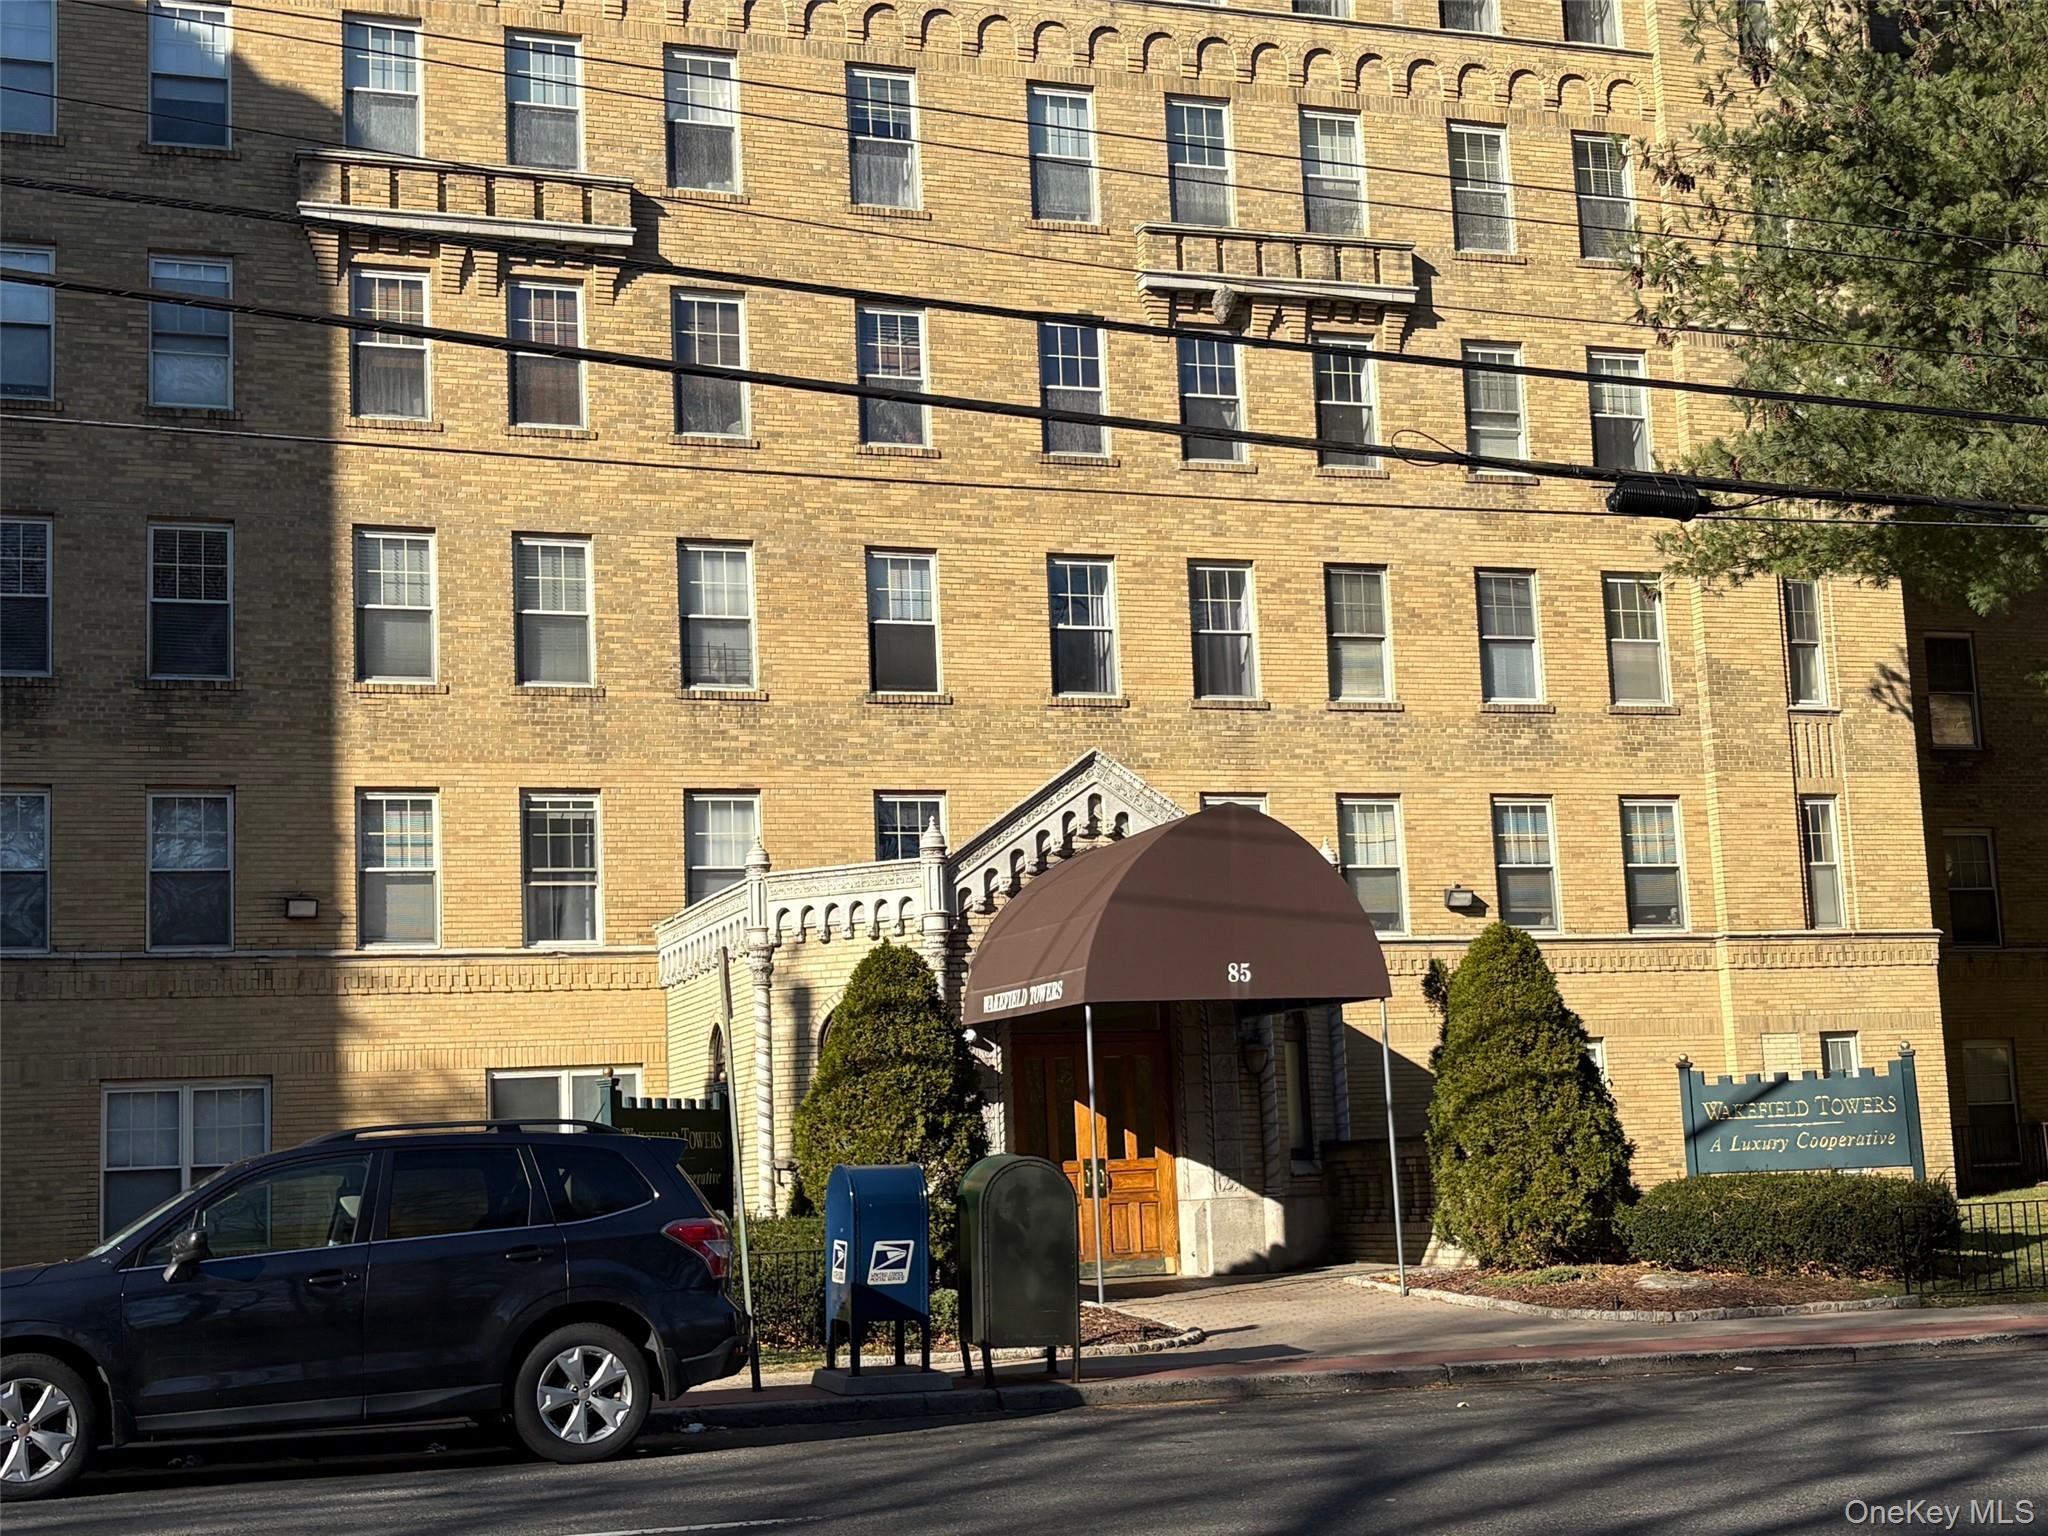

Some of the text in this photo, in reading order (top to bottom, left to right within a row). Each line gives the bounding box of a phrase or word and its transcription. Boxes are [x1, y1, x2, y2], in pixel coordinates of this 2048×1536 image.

[1228, 962, 1252, 983] 85
[1029, 980, 1063, 1005] TOWERS
[1701, 1095, 1897, 1120] WAKEFIELD TOWERS
[1709, 1130, 1896, 1153] A Luxury Cooperative
